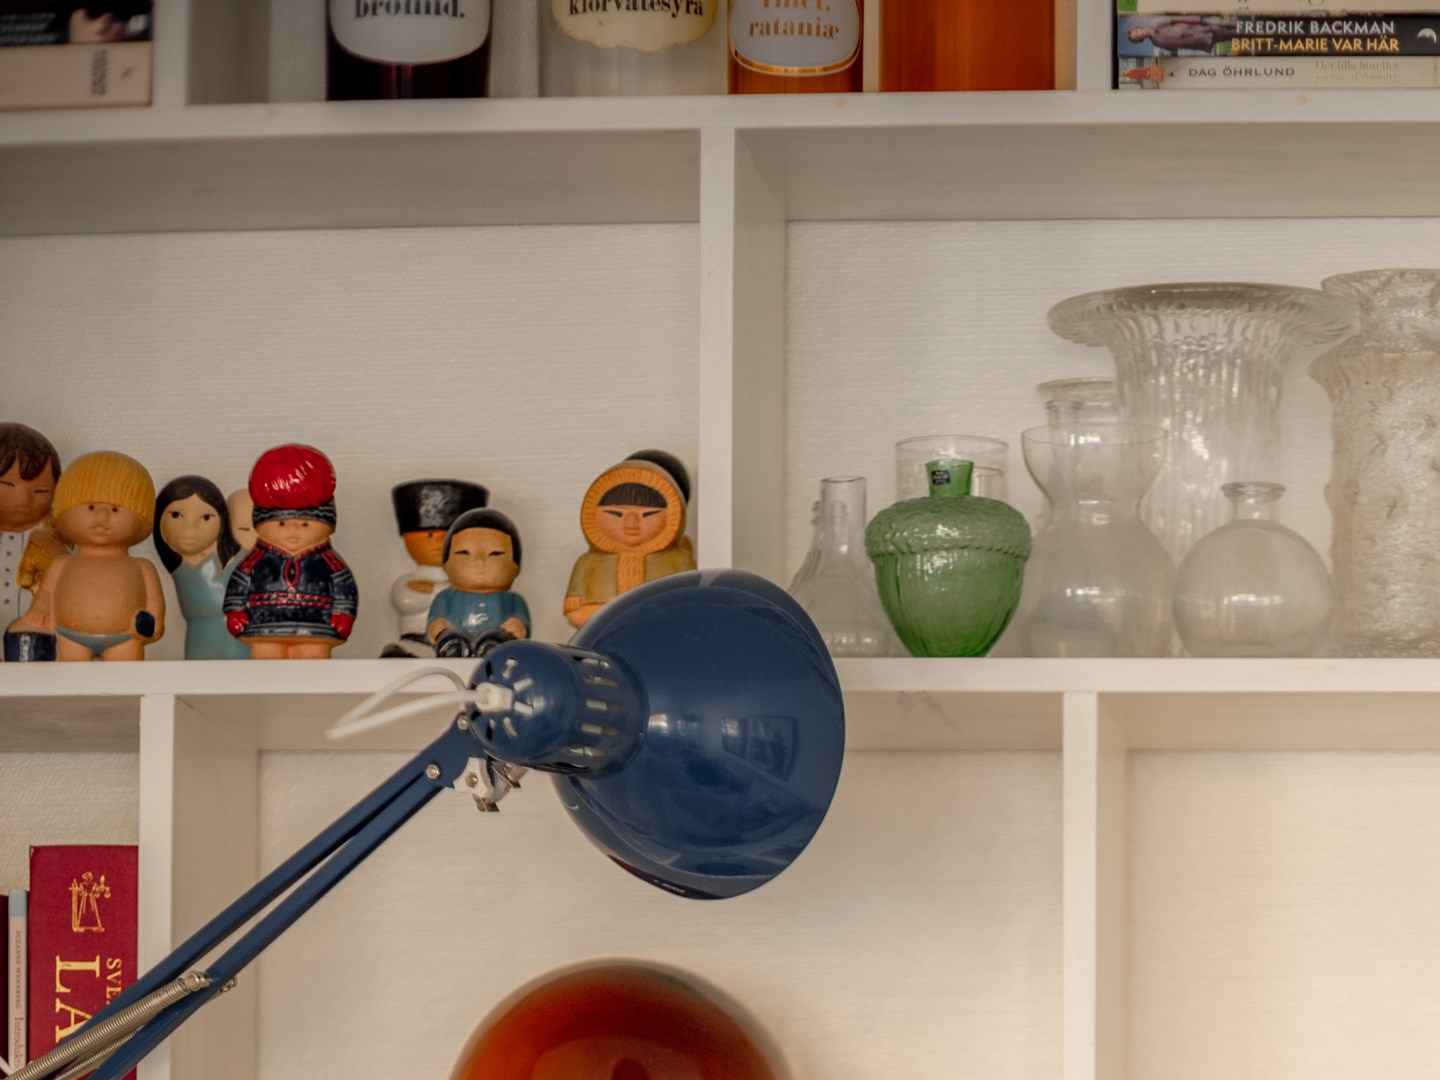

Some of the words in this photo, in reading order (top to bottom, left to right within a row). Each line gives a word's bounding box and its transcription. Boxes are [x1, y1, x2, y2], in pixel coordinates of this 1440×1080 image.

[1236, 21, 1305, 34] FREDRIK
[1310, 21, 1395, 34] BACKMAN
[1231, 39, 1328, 51] BRITT-MARIE
[1332, 39, 1363, 51] VAR
[1366, 36, 1399, 51] HÄR
[1189, 68, 1216, 77] DAG
[1222, 65, 1295, 77] ÖHRLUND
